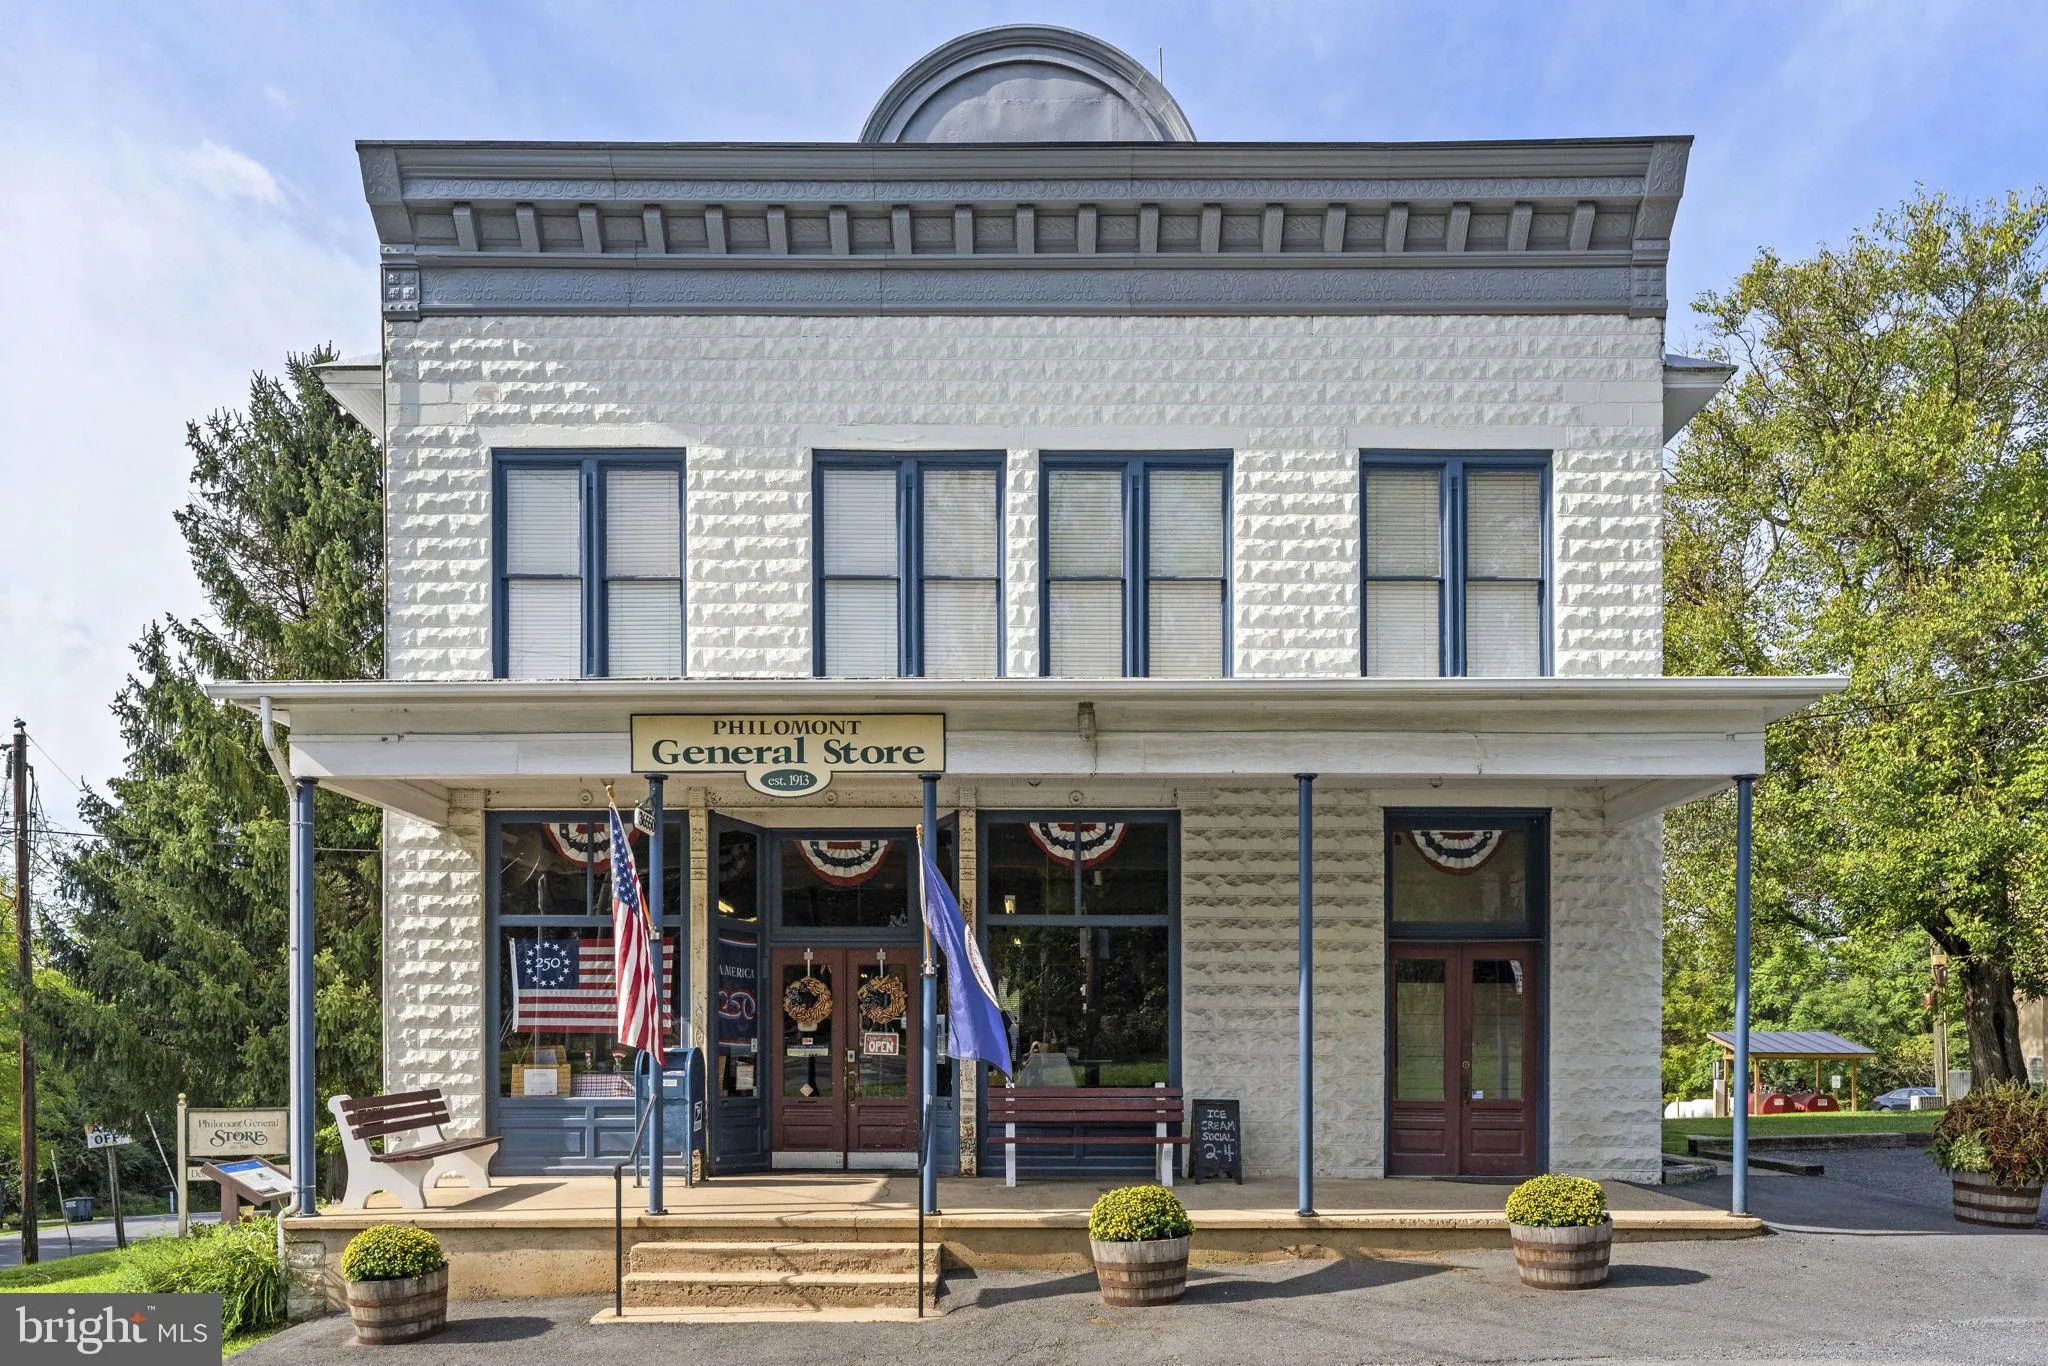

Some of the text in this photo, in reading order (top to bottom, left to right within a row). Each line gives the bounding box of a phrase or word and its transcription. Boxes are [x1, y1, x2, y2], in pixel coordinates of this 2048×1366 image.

[713, 720, 861, 736] PHILOMONT
[652, 736, 926, 765] General Store
[768, 775, 810, 786] est. 1913
[535, 957, 561, 972] 250
[868, 1041, 894, 1053] OPEN
[1206, 1109, 1227, 1119] ICE
[198, 1118, 279, 1129] Philomont General
[1201, 1120, 1236, 1131] CREAM
[209, 1129, 268, 1148] STORE
[1201, 1131, 1236, 1142] SOCIAL
[1203, 1143, 1235, 1162] 2-4
